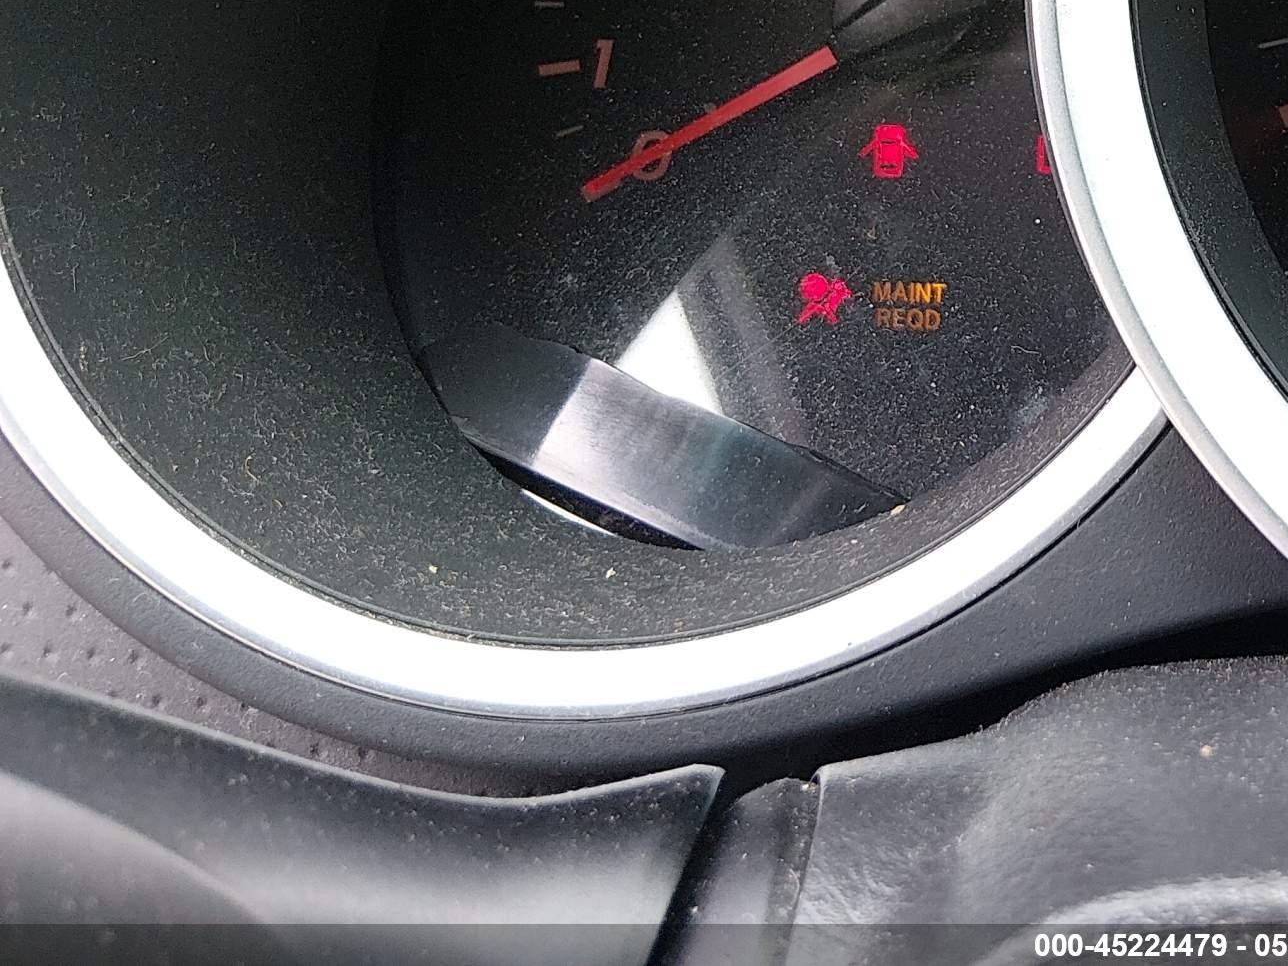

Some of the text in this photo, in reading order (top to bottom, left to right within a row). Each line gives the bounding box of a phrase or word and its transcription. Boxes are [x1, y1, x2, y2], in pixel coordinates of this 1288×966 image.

[593, 39, 614, 88] 1
[872, 281, 947, 303] MAINT
[875, 307, 942, 331] REQD
